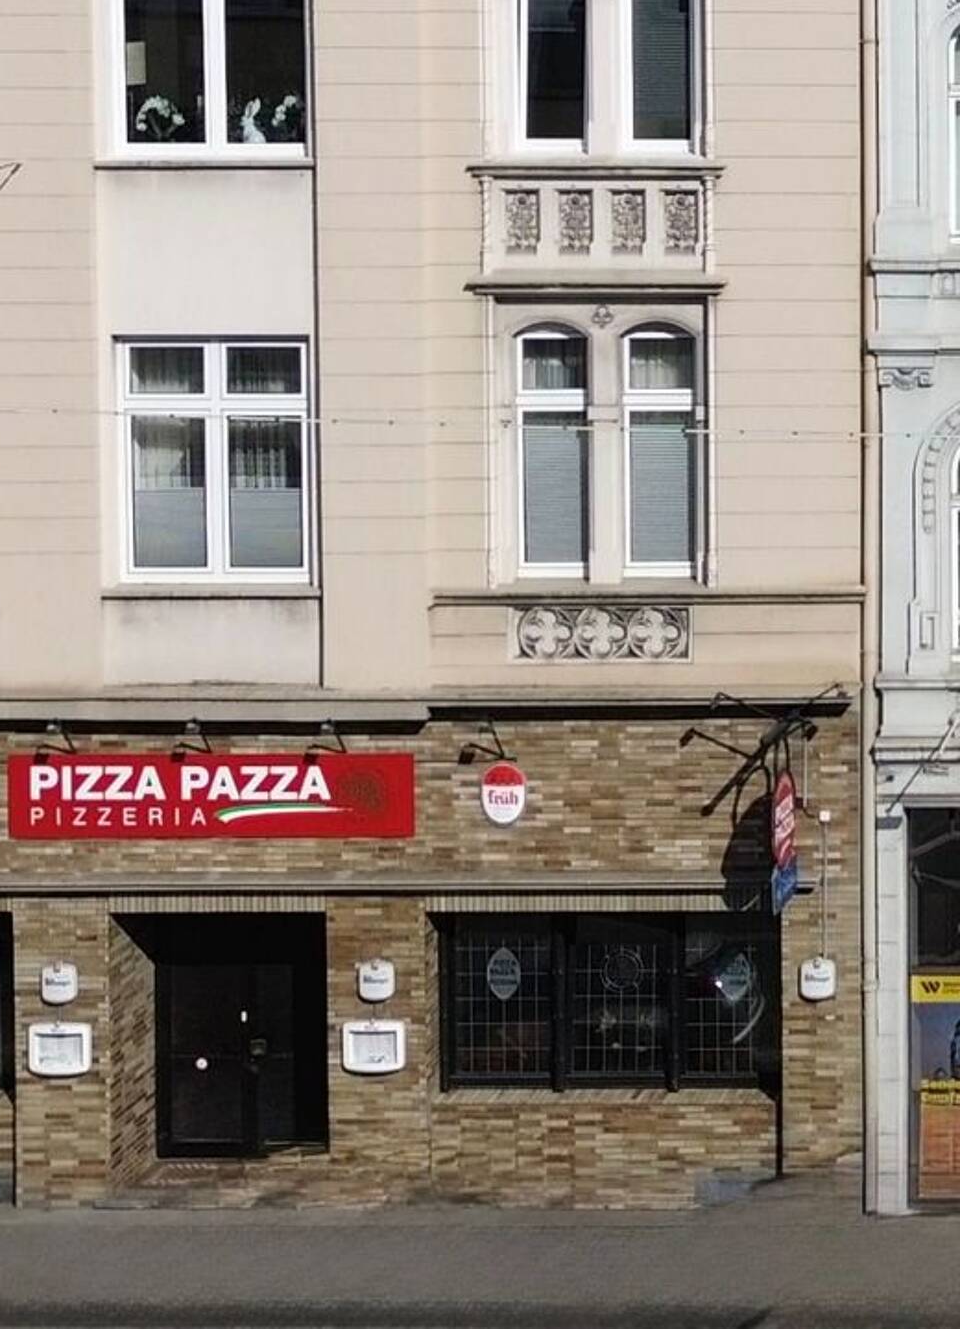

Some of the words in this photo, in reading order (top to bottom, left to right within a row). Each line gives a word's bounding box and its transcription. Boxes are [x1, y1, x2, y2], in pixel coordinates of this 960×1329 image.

[29, 765, 166, 801] PIZZA
[180, 765, 331, 801] PAZZA
[29, 806, 207, 827] PIZZERIA
